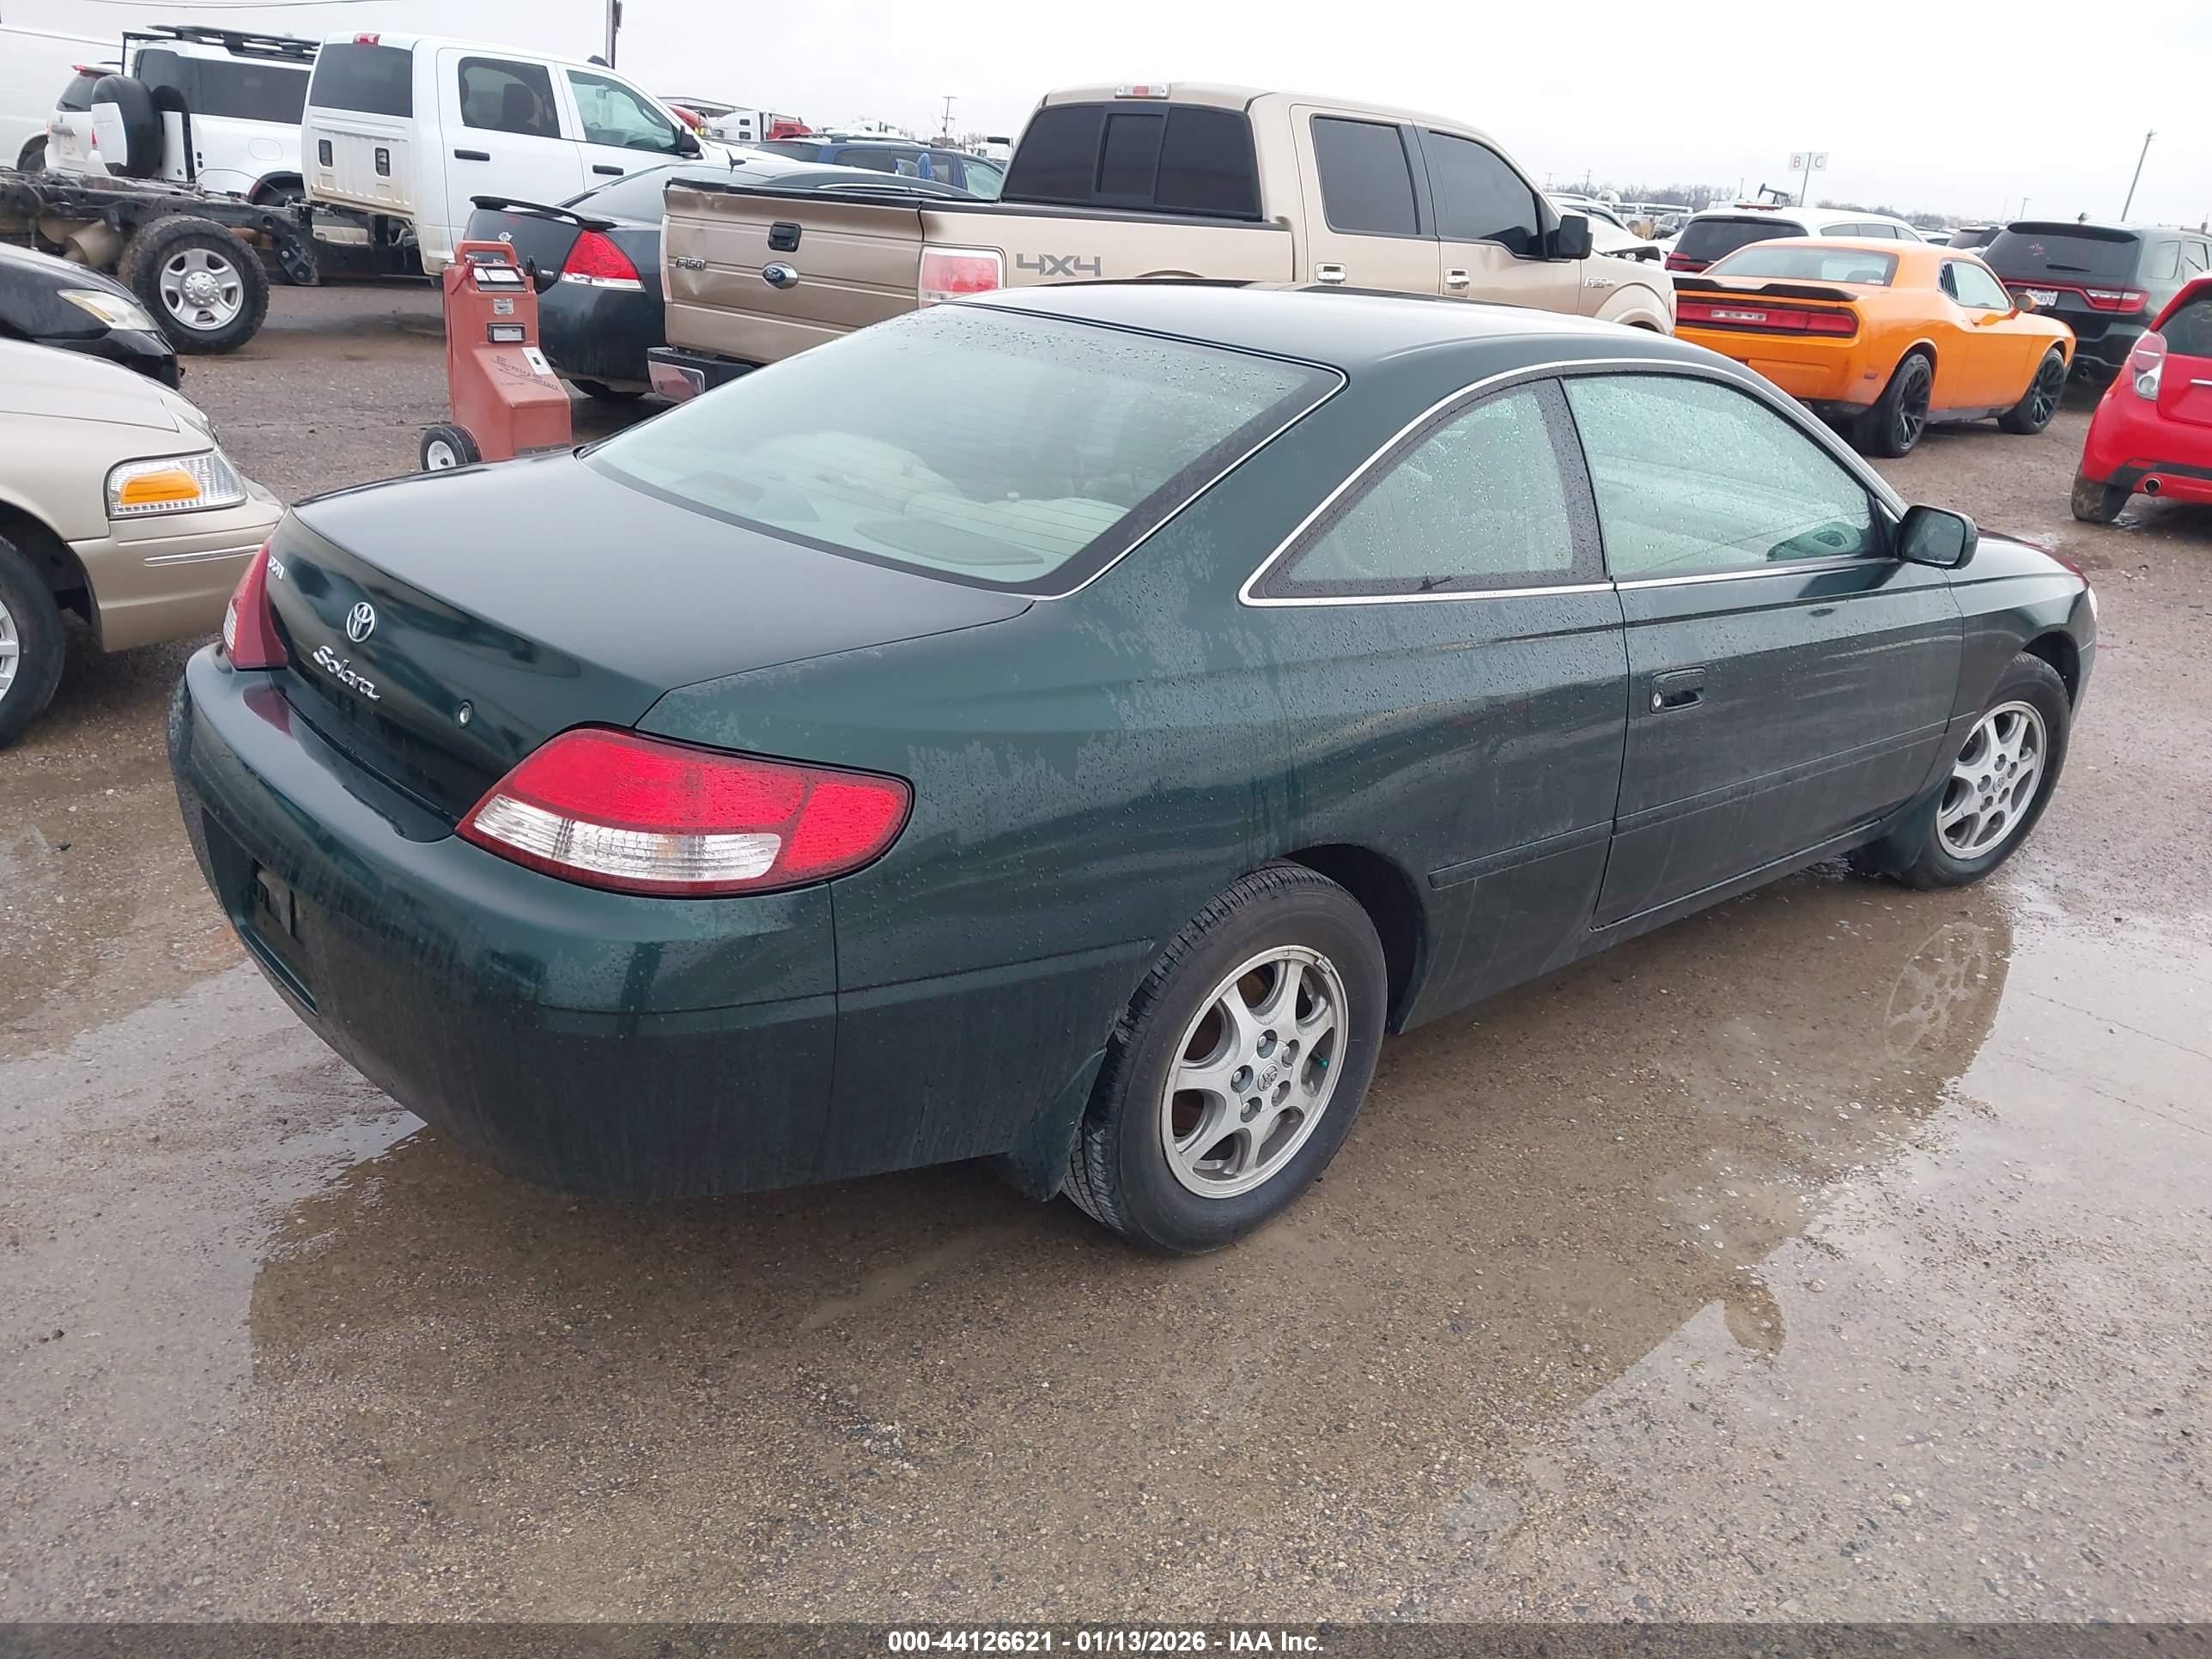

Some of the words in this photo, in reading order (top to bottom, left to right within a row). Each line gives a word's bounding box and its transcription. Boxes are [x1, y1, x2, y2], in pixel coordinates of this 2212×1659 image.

[1793, 155, 1801, 168] B
[1814, 155, 1824, 168] C
[313, 646, 380, 701] Solara
